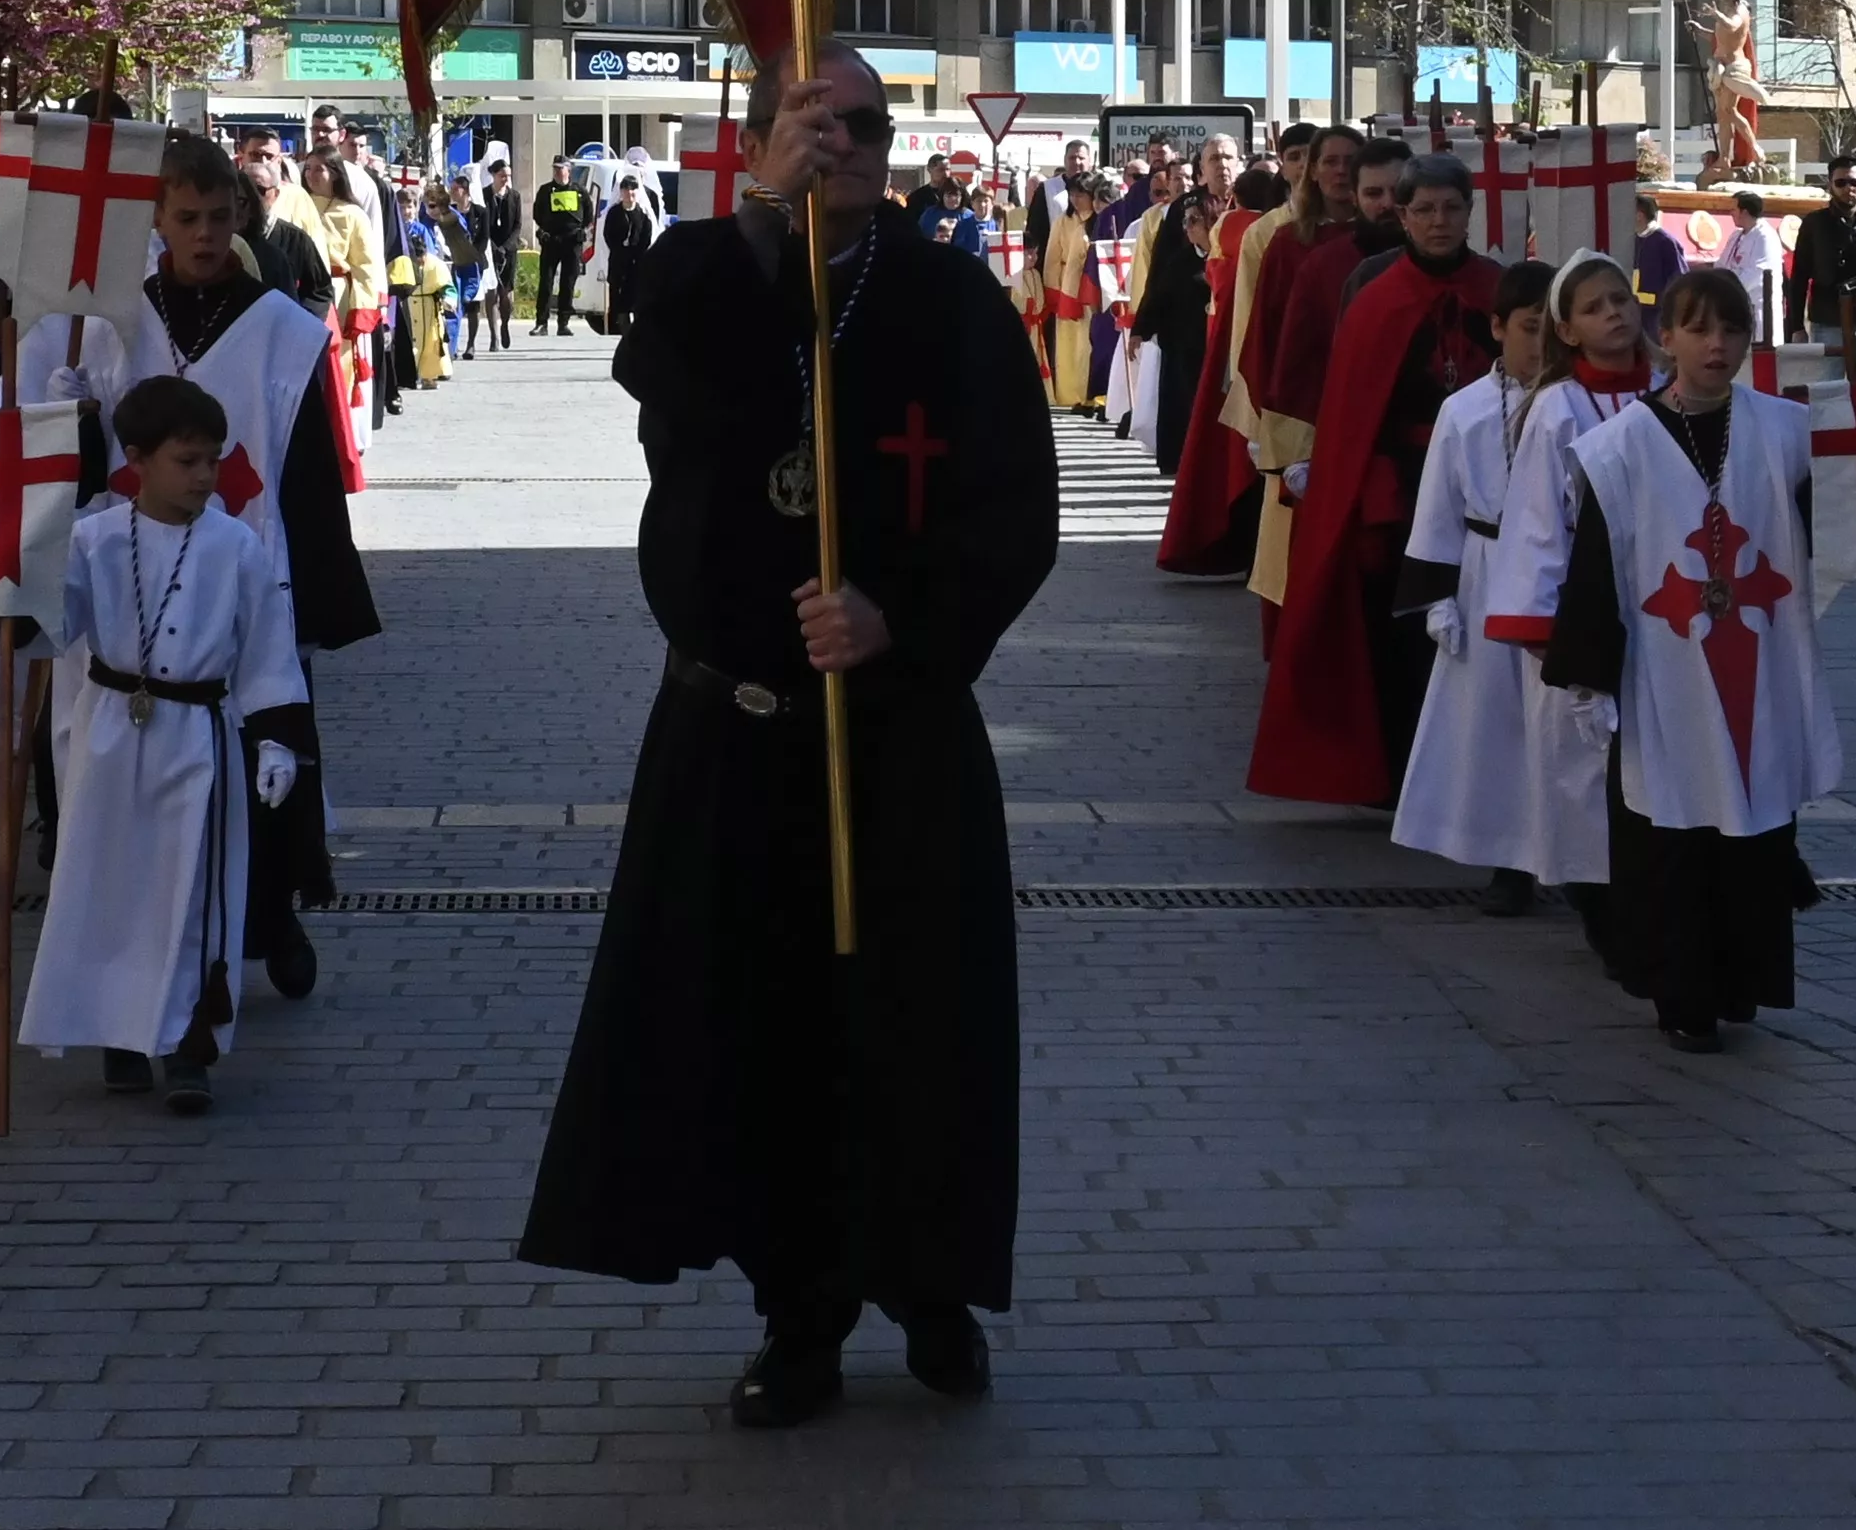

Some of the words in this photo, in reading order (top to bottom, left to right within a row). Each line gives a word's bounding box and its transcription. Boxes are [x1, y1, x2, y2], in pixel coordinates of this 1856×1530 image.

[300, 33, 343, 44] REPASO
[626, 51, 680, 74] SCIO
[1130, 125, 1207, 137] ENCUENTRO
